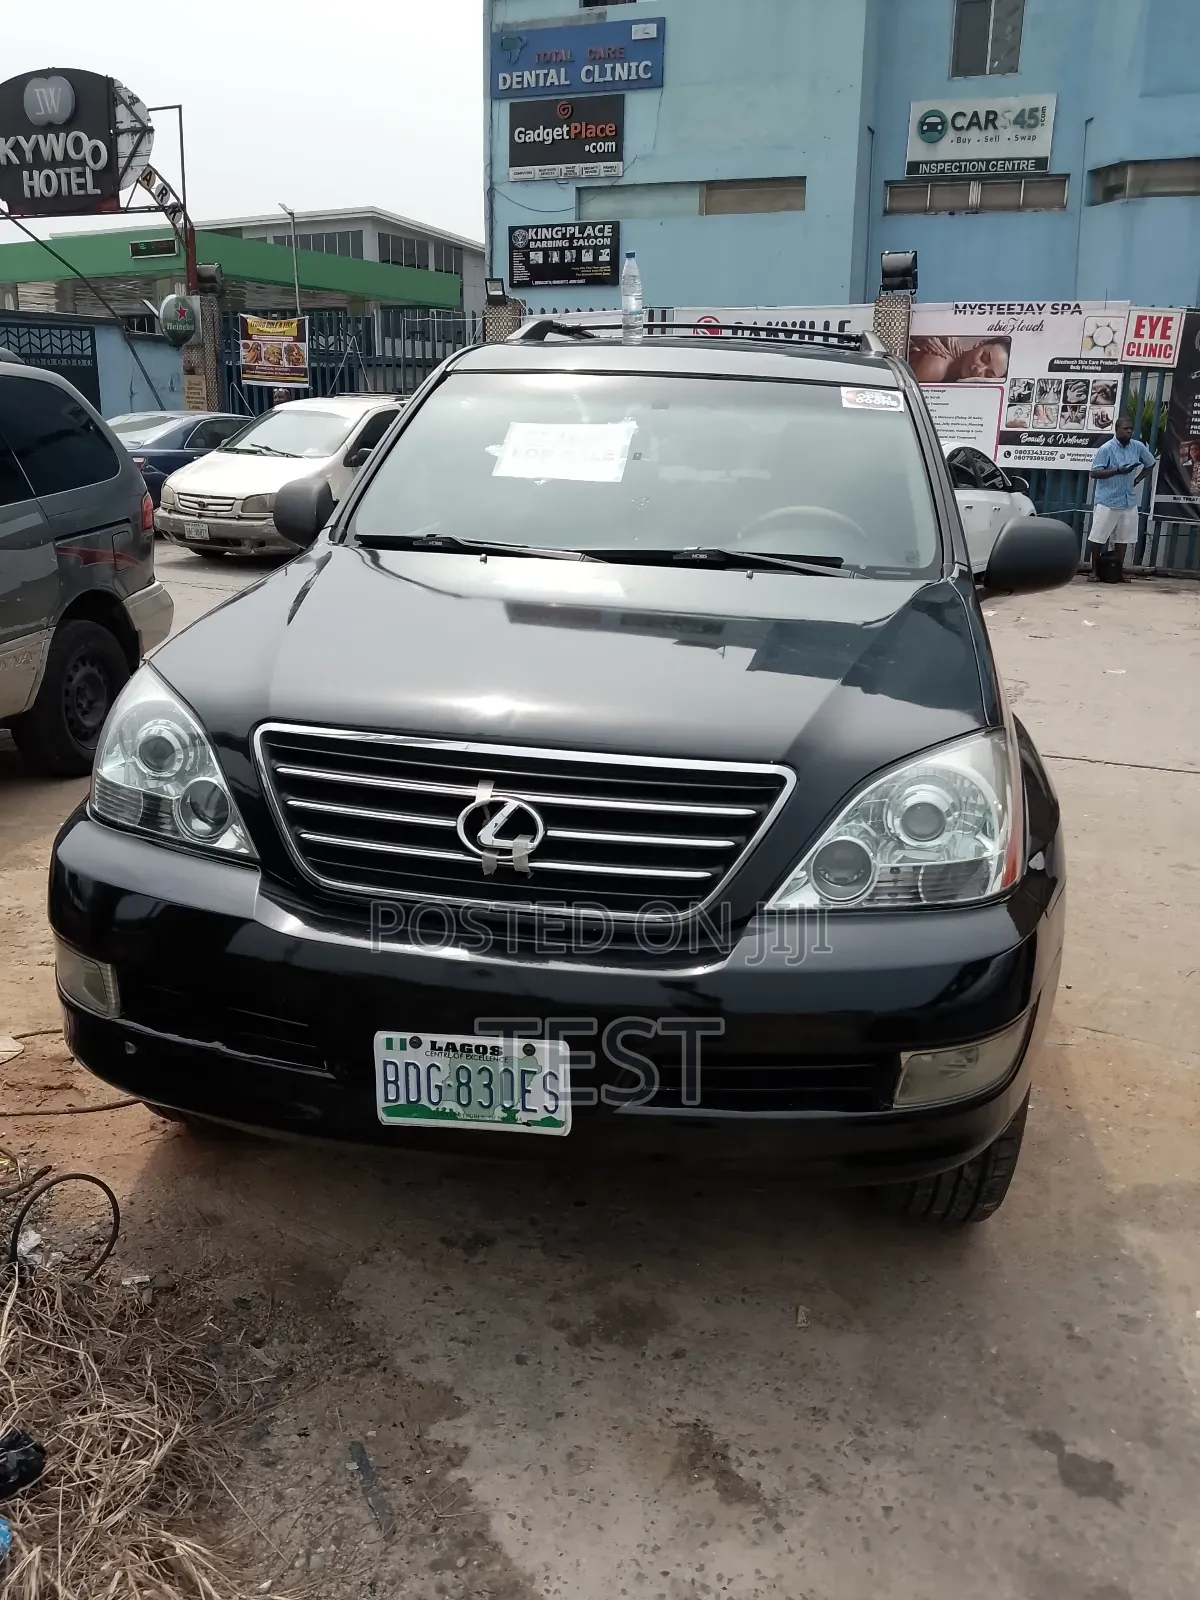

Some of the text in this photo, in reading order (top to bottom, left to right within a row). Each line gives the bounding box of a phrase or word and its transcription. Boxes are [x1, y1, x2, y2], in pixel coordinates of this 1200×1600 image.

[498, 60, 652, 90] DENTAL CLINIC
[514, 122, 616, 145] GadgetPlace
[956, 134, 1037, 144] Buy Sell Swap
[584, 141, 616, 154] .com
[919, 160, 1036, 174] INSPECTION CENTRE
[22, 166, 102, 199] HOTEL
[566, 225, 613, 238] PLACE
[529, 238, 611, 248] BARBING SALOON
[953, 302, 1083, 315] MYSTEEJAY SPA
[1133, 314, 1174, 340] EYE
[1126, 341, 1173, 359] CLINIC
[1020, 433, 1045, 445] Beauty
[1056, 433, 1090, 446] Wellness
[429, 1040, 504, 1056] LAGOS
[424, 1050, 509, 1064] CENTRE OF EXCELLENCE
